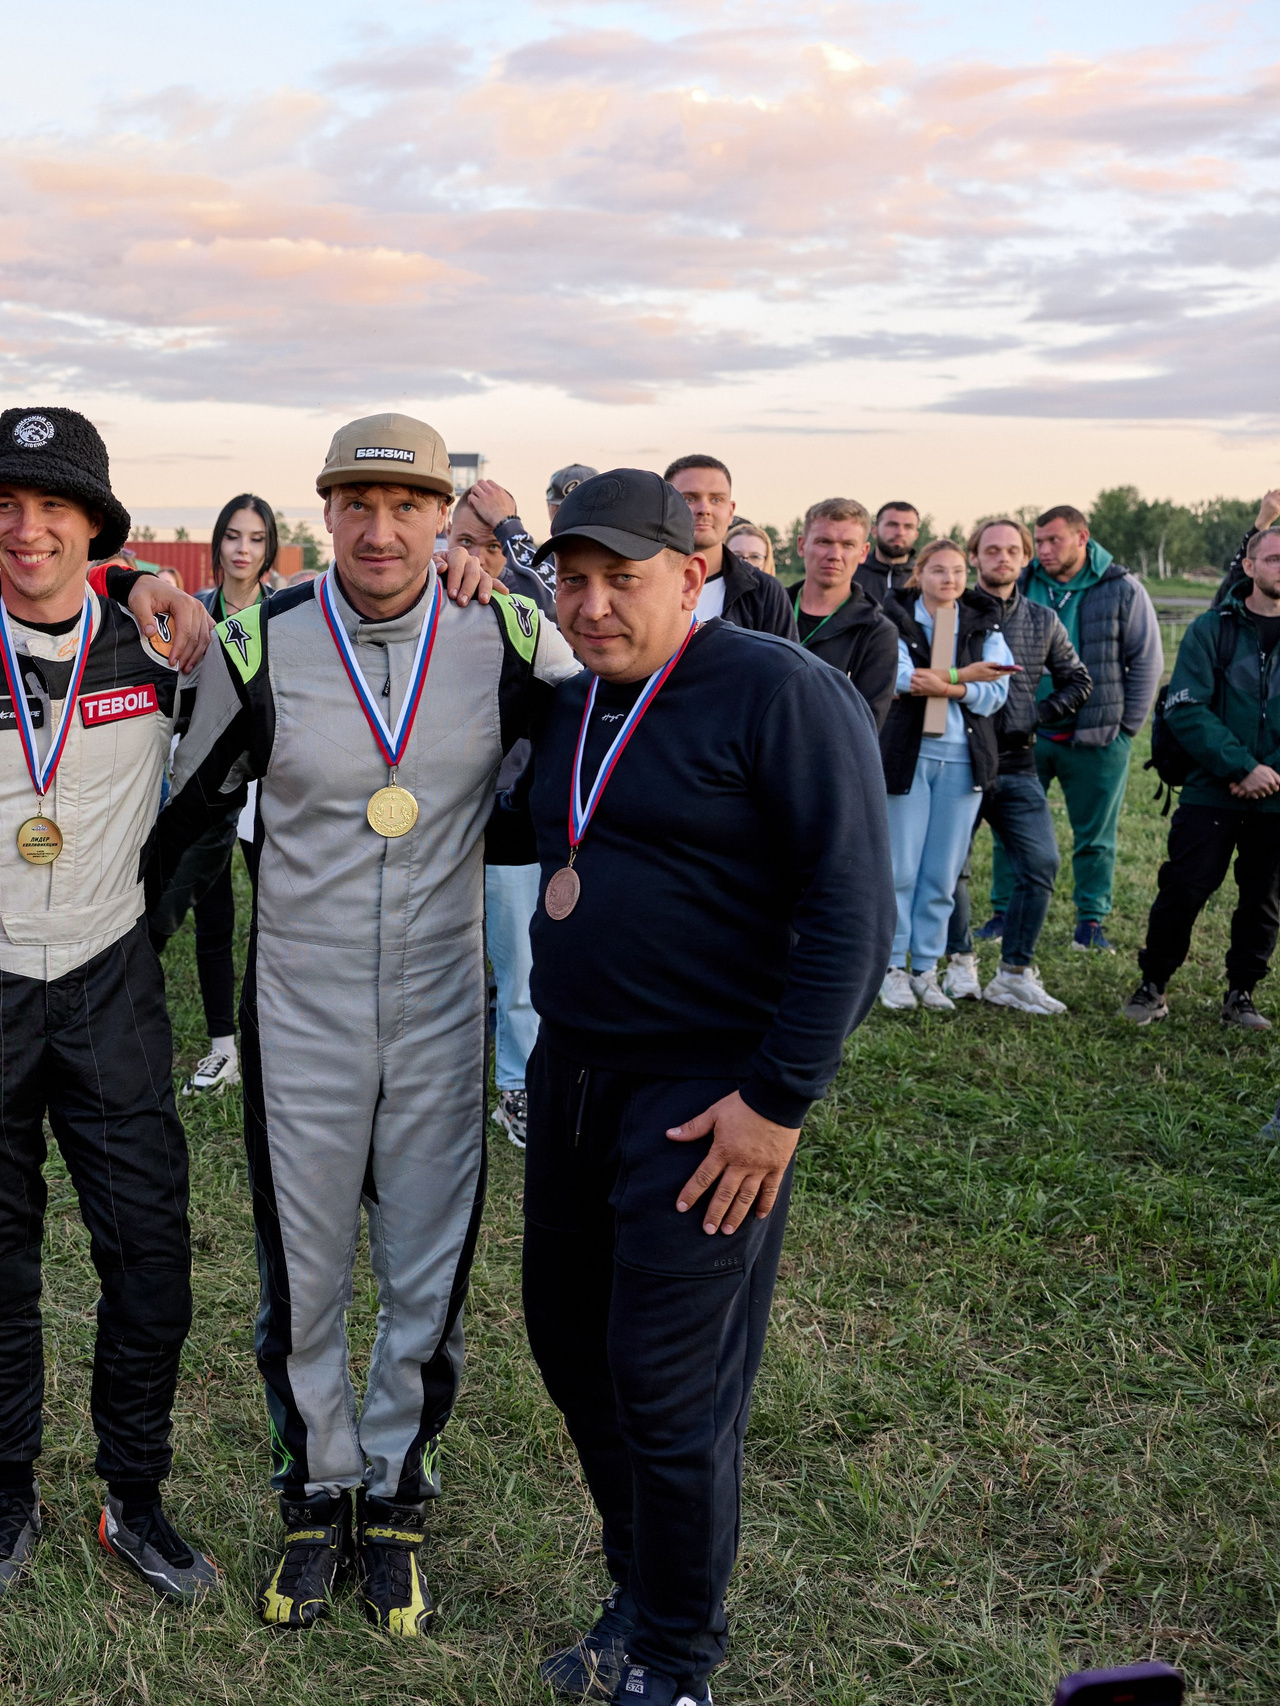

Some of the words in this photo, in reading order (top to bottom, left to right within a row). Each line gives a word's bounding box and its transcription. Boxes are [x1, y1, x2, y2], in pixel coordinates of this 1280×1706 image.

[84, 690, 154, 719] TEBOIL
[713, 1257, 739, 1267] BOSS
[627, 1683, 643, 1693] 574
